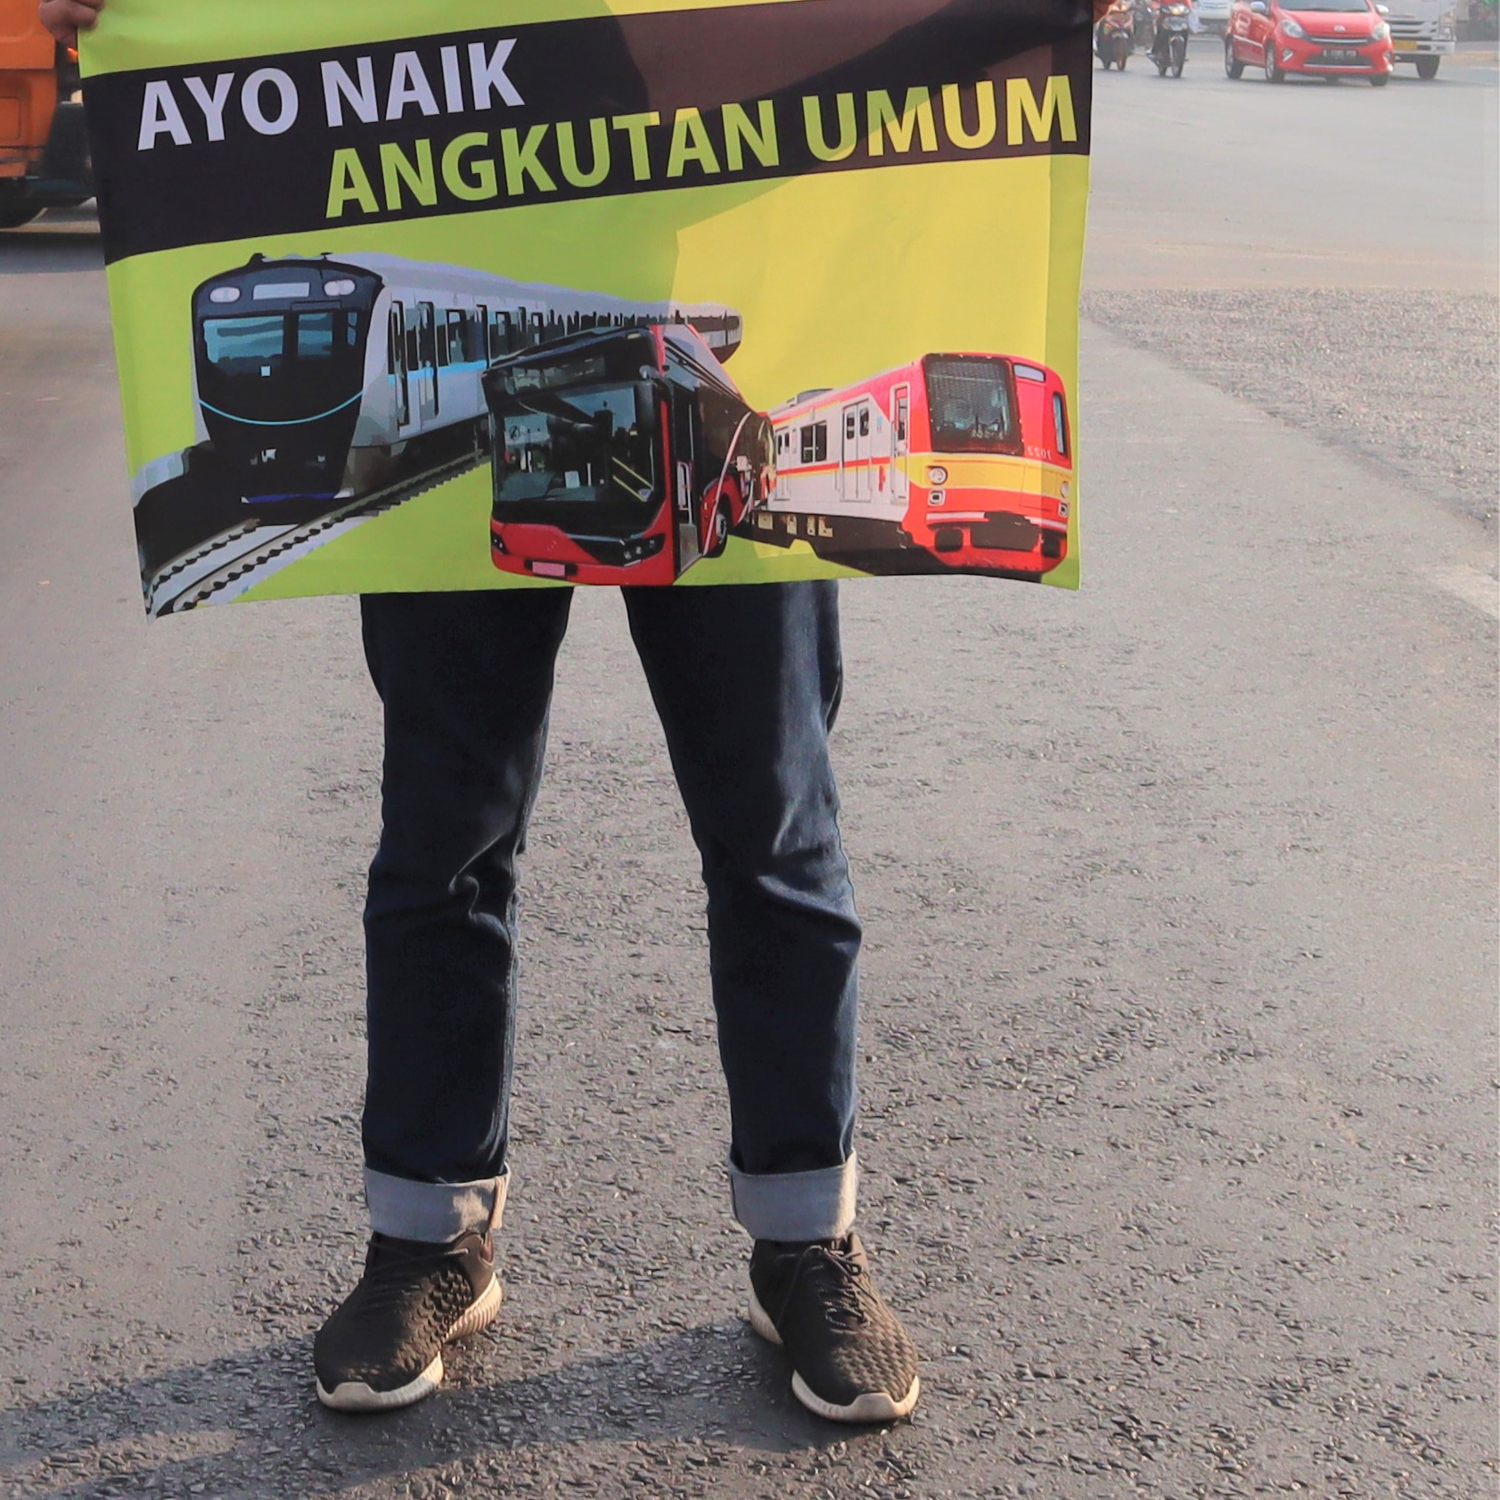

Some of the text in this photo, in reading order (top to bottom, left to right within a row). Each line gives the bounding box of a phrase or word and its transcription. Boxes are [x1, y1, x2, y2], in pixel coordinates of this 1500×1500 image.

[138, 37, 525, 151] AYO NAIK
[326, 74, 1077, 219] ANGKUTAN UMUM
